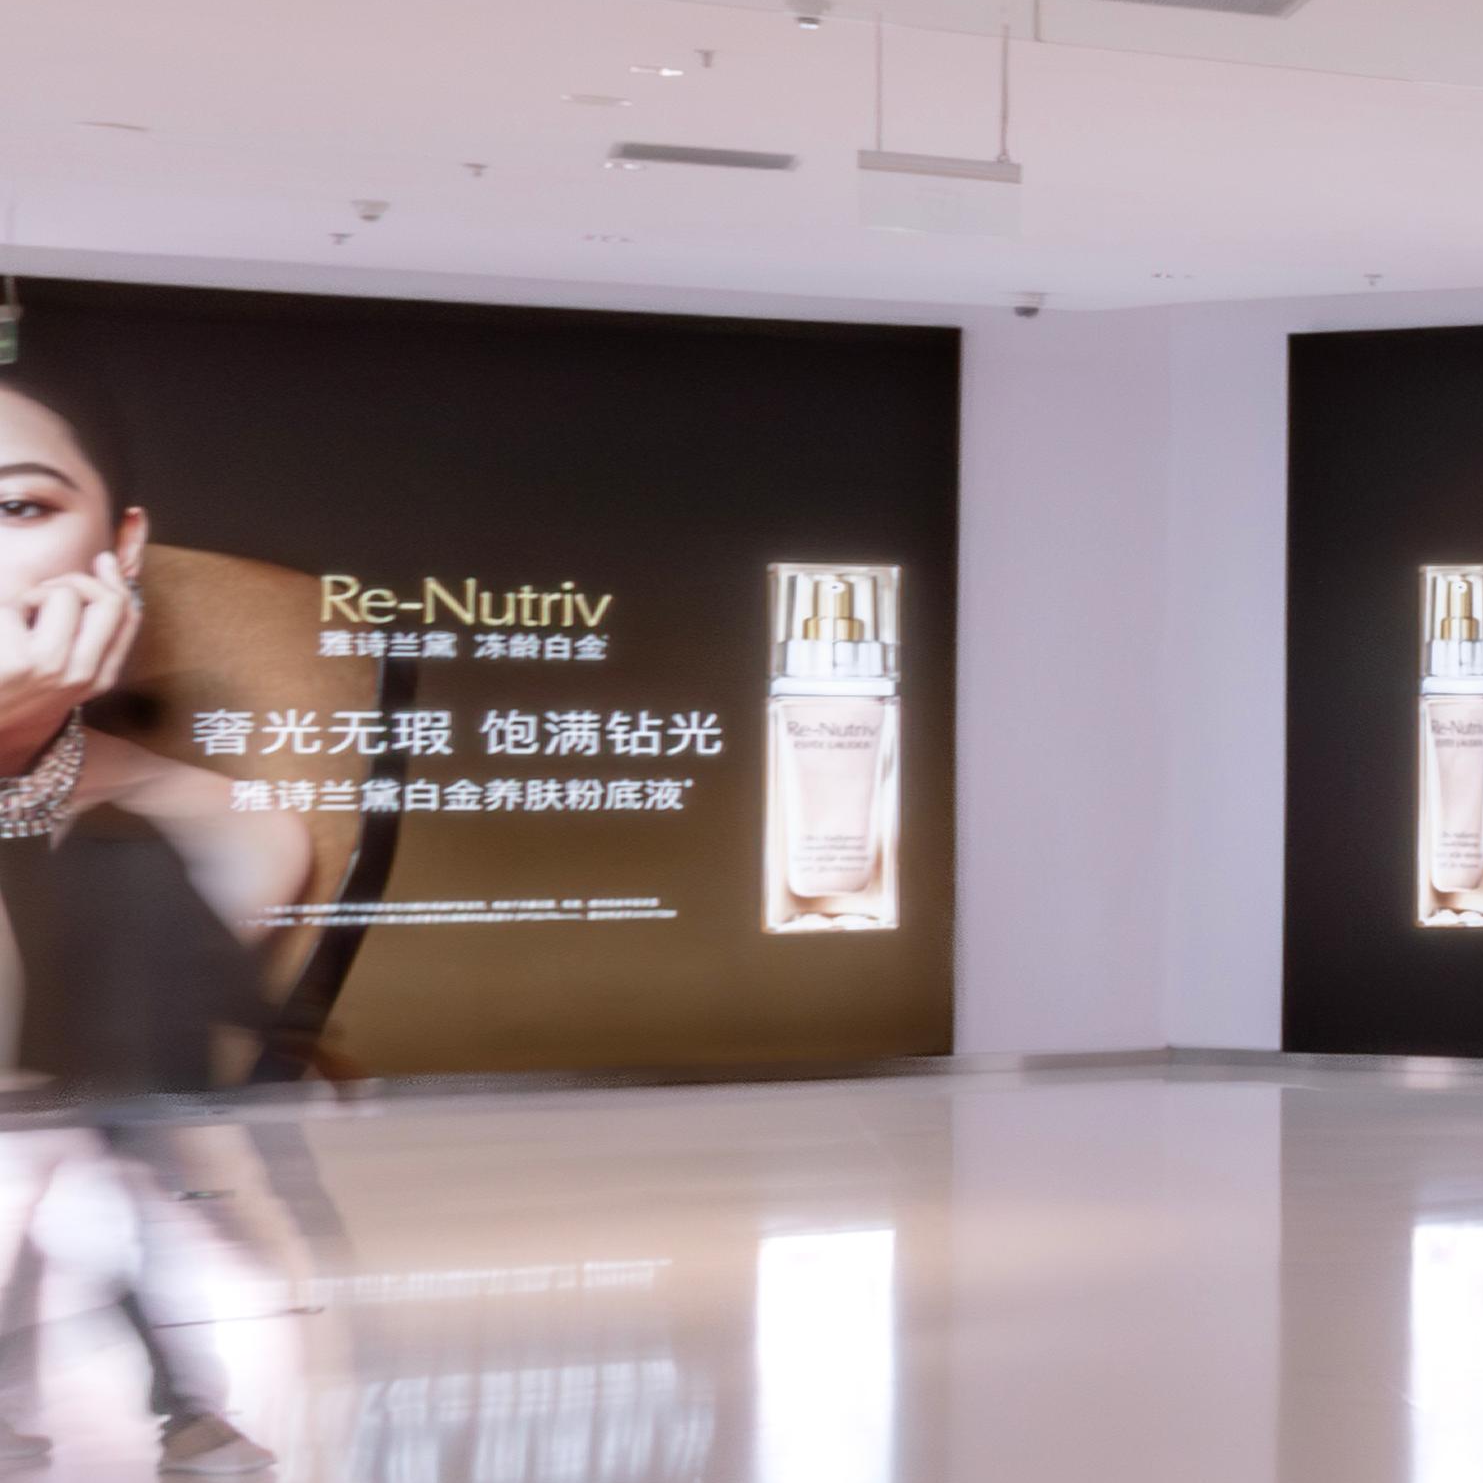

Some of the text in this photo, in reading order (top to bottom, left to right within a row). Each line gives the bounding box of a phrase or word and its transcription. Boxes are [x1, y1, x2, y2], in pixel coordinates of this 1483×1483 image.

[320, 574, 613, 627] Re-Nutriv
[192, 707, 724, 757] 奢光无瑕 饱满钻光
